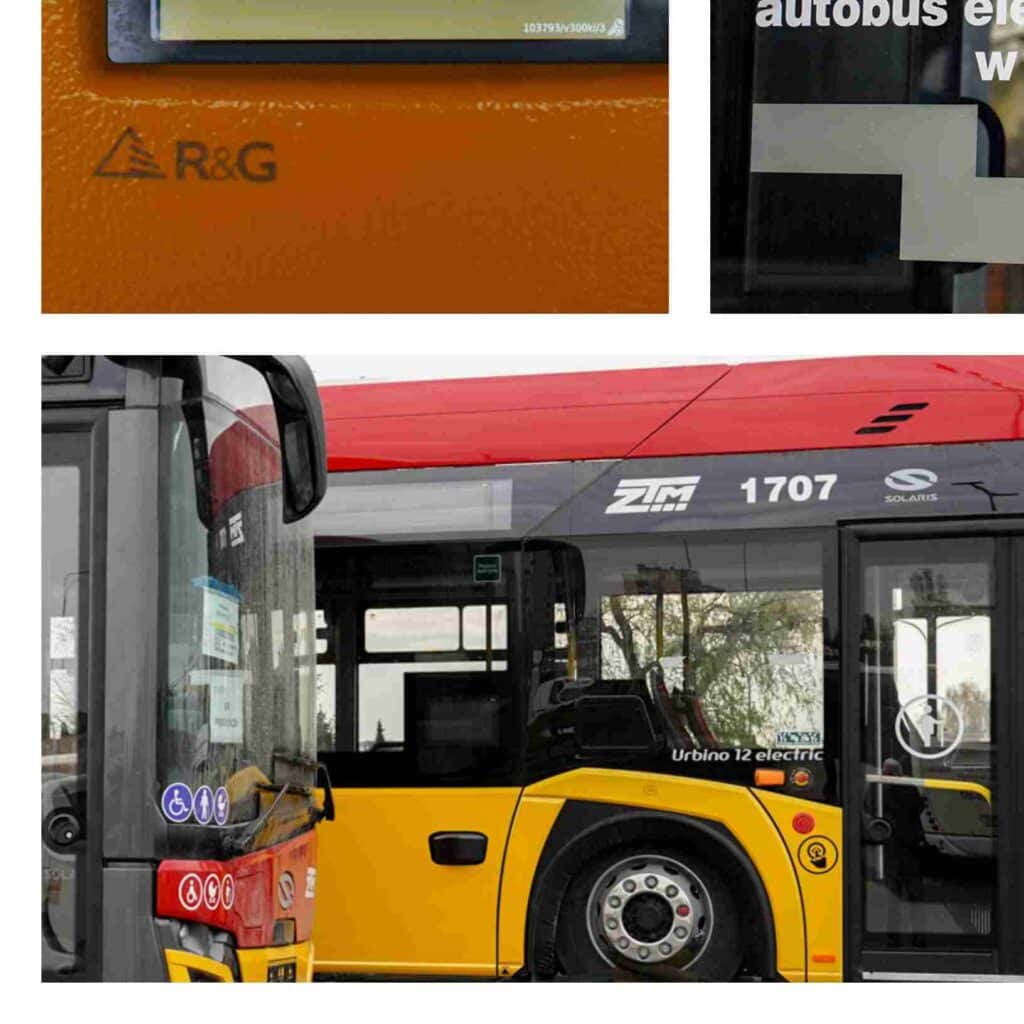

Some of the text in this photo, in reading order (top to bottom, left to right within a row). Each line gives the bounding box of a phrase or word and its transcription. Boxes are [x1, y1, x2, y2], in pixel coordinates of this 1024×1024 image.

[975, 53, 1017, 81] w
[176, 141, 278, 183] R&G
[604, 473, 837, 514] ZTM 1707
[884, 493, 938, 503] SOLARIS
[671, 749, 824, 762] Urbino 12 electric
